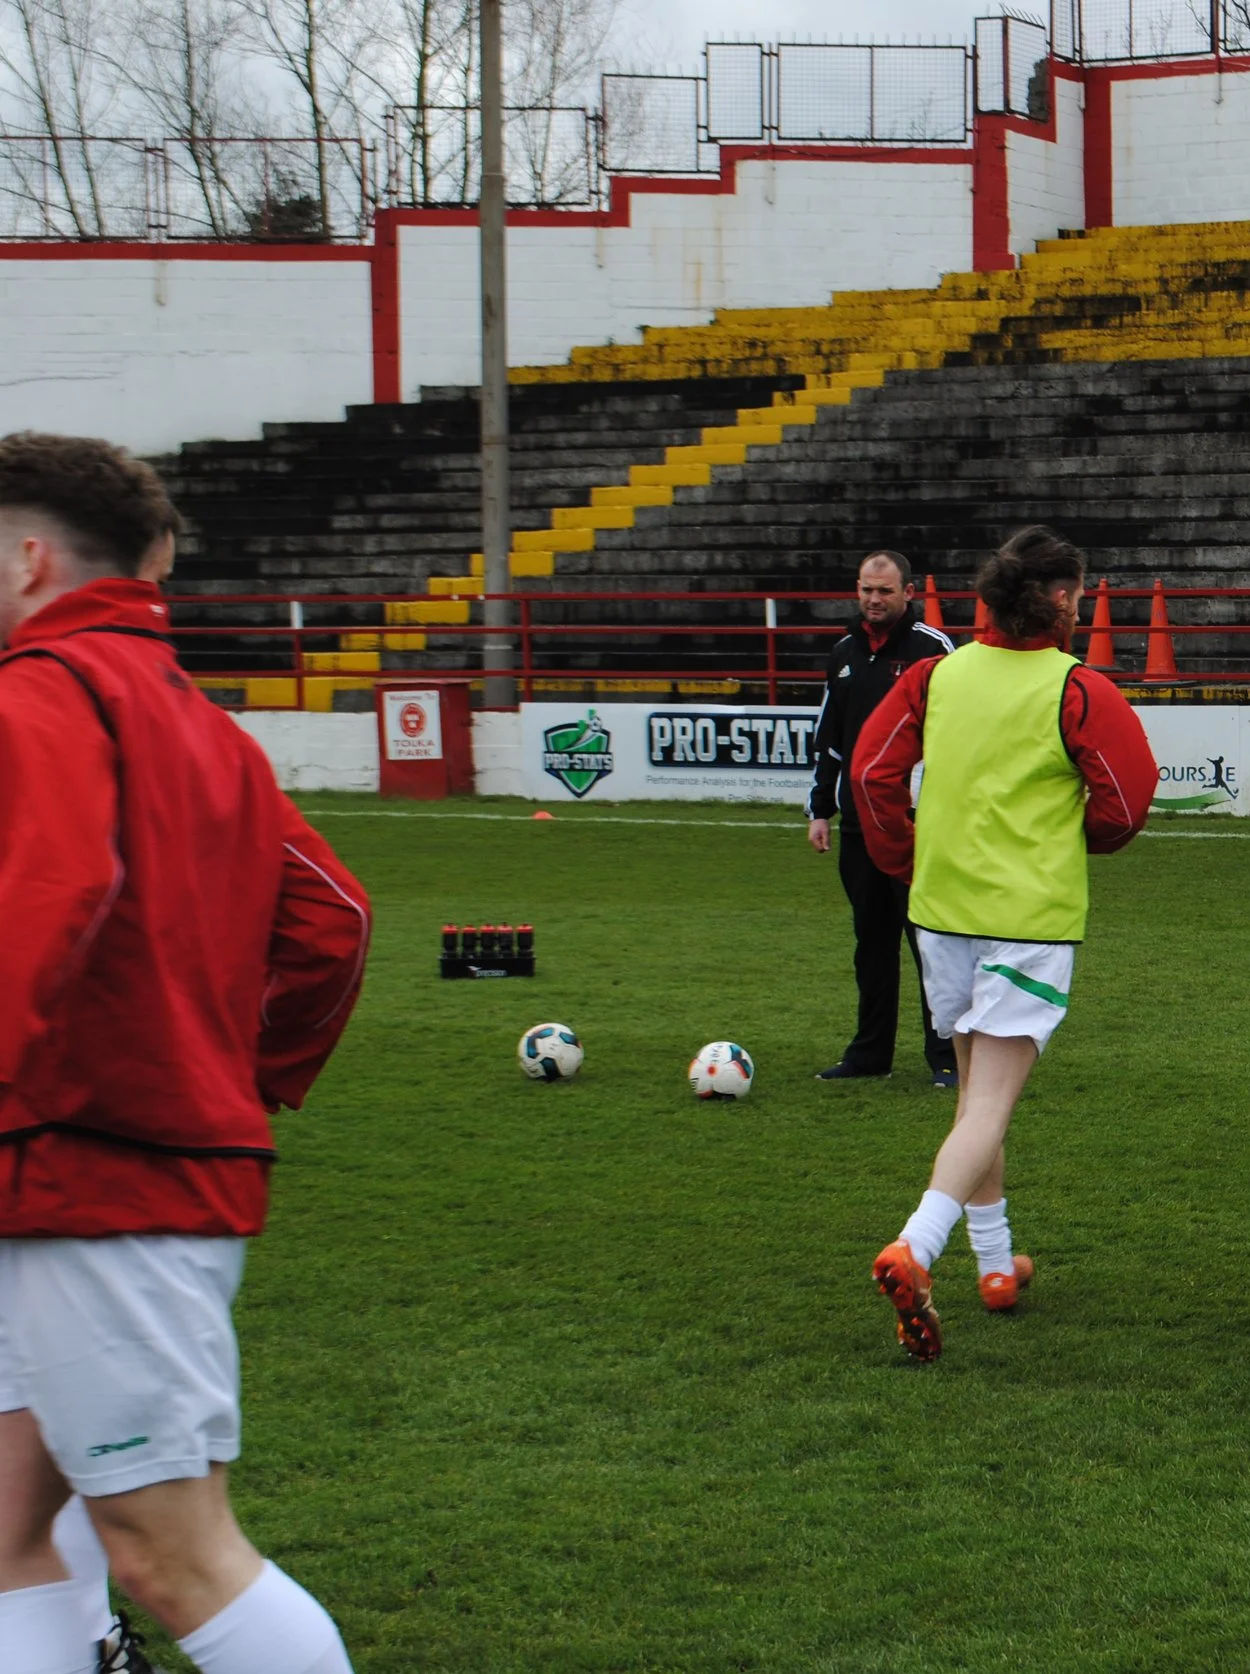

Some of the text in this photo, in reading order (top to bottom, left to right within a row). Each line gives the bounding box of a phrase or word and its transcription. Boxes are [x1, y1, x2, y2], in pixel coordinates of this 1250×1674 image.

[650, 717, 819, 764] PRO-STAT
[398, 749, 432, 757] PARK
[544, 753, 612, 769] PRO-STATS
[646, 775, 814, 789] Performance Analysis for the Footballin
